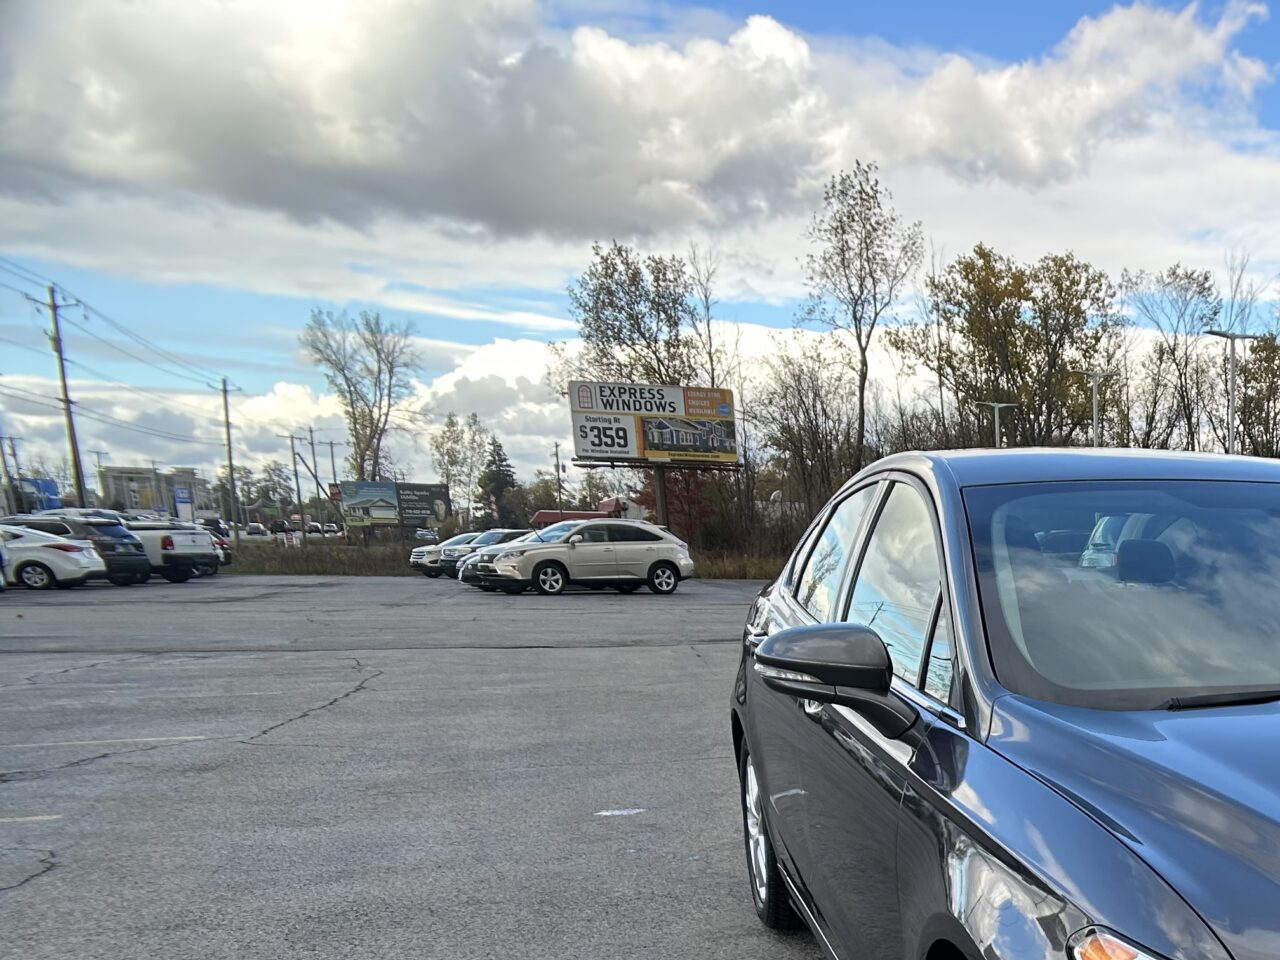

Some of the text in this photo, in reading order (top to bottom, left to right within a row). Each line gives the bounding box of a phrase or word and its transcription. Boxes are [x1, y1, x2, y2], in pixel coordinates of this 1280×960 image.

[599, 385, 665, 400] EXPRESS
[600, 398, 677, 413] WINDOWS
[584, 415, 621, 425] Starting At
